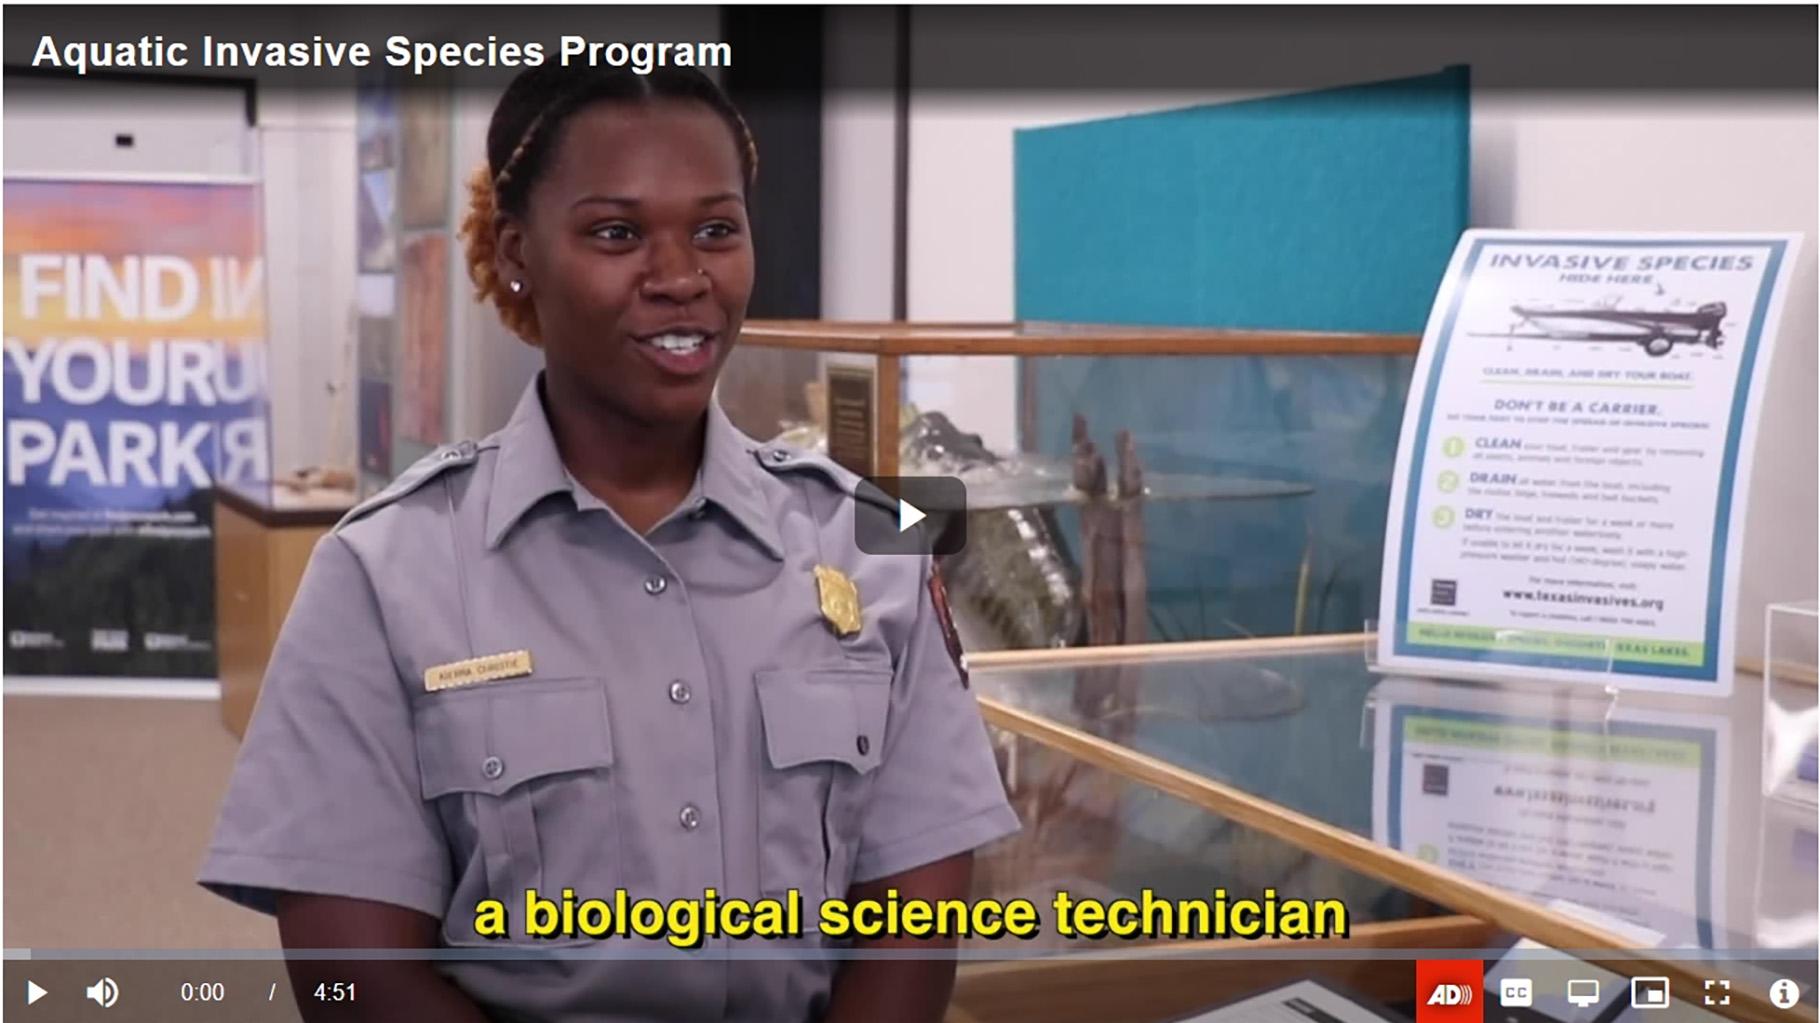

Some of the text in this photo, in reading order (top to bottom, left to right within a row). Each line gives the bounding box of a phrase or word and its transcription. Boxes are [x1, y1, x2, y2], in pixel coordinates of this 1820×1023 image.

[1490, 253, 1754, 271] INVASIVE SPECIES
[20, 253, 198, 322] FIND
[1559, 273, 1653, 285] HIDE HERE
[4, 337, 217, 407] YOUR
[1494, 398, 1662, 416] DON'T BE A CARRIER.
[1475, 436, 1522, 449] CLEAN
[7, 419, 213, 488] PARK
[1469, 471, 1517, 485] DRAIN
[1465, 507, 1493, 520] DRY
[1502, 588, 1664, 611] www.texasinvasives.org
